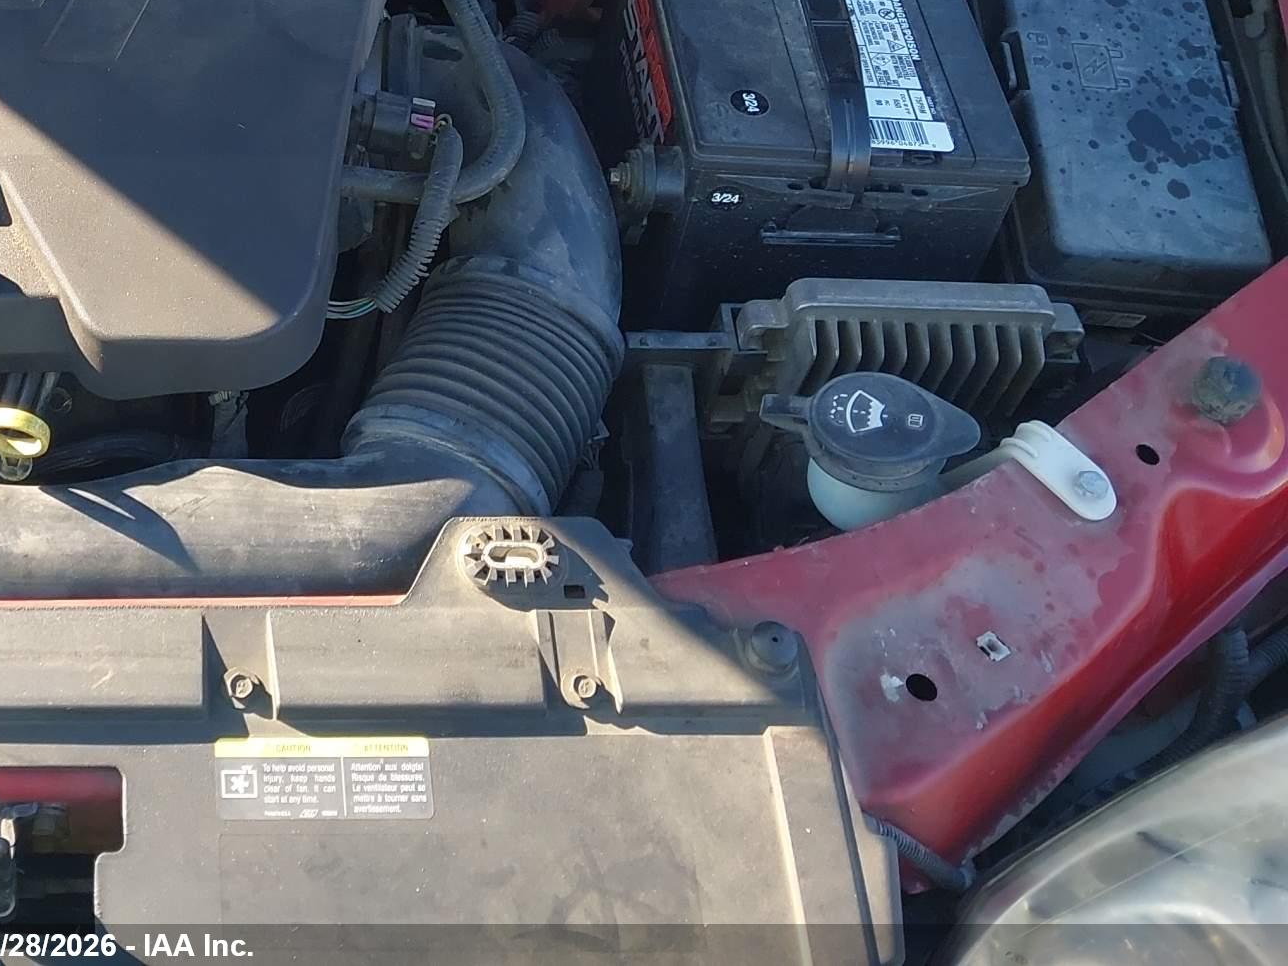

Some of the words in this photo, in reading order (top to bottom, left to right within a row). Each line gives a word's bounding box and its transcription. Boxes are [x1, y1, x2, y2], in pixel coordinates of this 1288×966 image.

[742, 93, 760, 112] 3/24
[712, 193, 739, 203] 3/24
[263, 763, 270, 772] To
[272, 764, 286, 773] help
[288, 764, 306, 772] avoid
[307, 764, 335, 773] personal
[351, 763, 381, 771] Attention
[291, 775, 308, 784] keep
[314, 774, 336, 783] hands
[352, 774, 374, 783] Risque
[400, 784, 416, 793] peut
[289, 796, 300, 804] any
